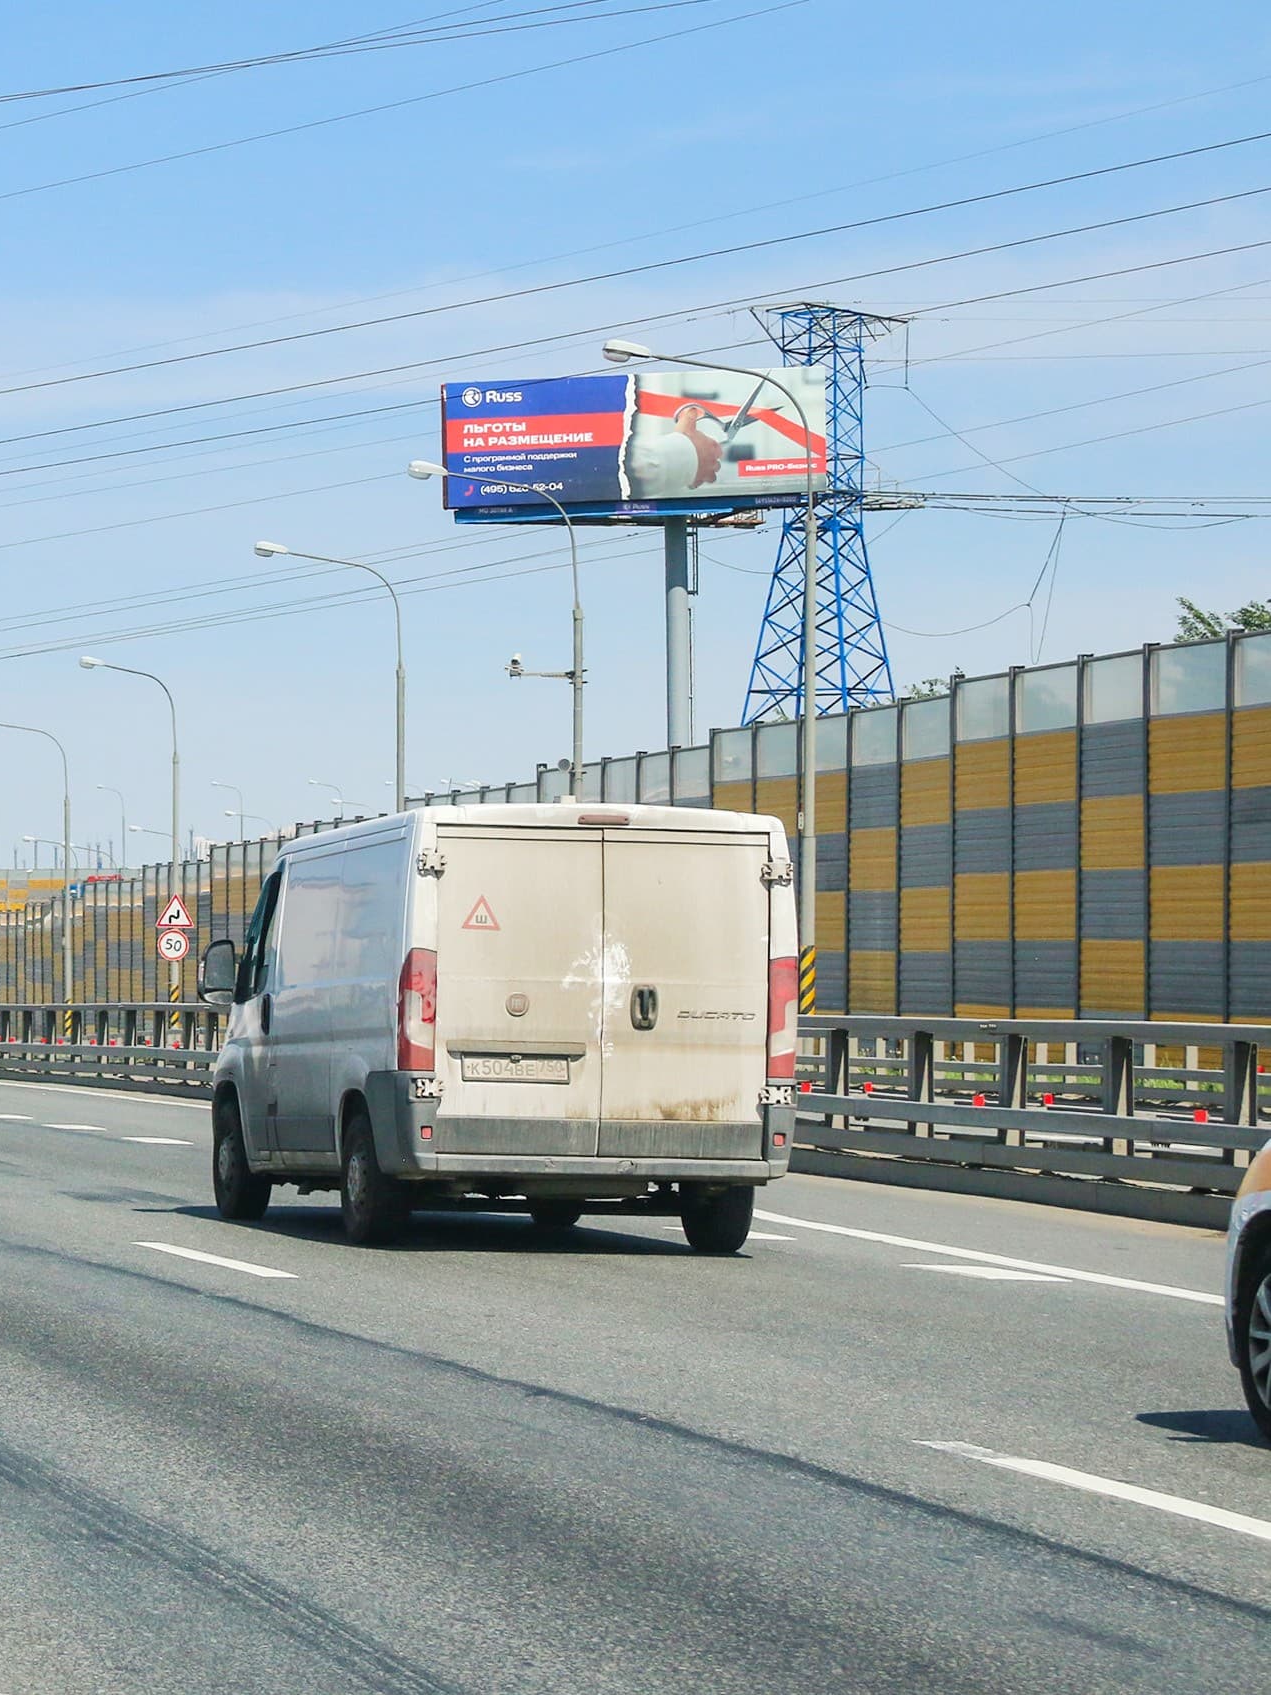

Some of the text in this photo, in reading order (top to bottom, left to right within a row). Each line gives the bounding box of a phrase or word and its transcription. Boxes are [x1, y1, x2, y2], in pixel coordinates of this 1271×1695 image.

[485, 390, 523, 403] Russ
[463, 421, 526, 434] ЛЬГОТЫ
[463, 432, 593, 447] НА РАЗМЕЩЕНИЕ
[463, 452, 578, 464] С программой поддержки
[463, 463, 533, 473] малого бизнеса
[745, 462, 818, 472] Russ PRO-бизнс
[480, 485, 507, 496] (495)
[165, 938, 182, 952] 50
